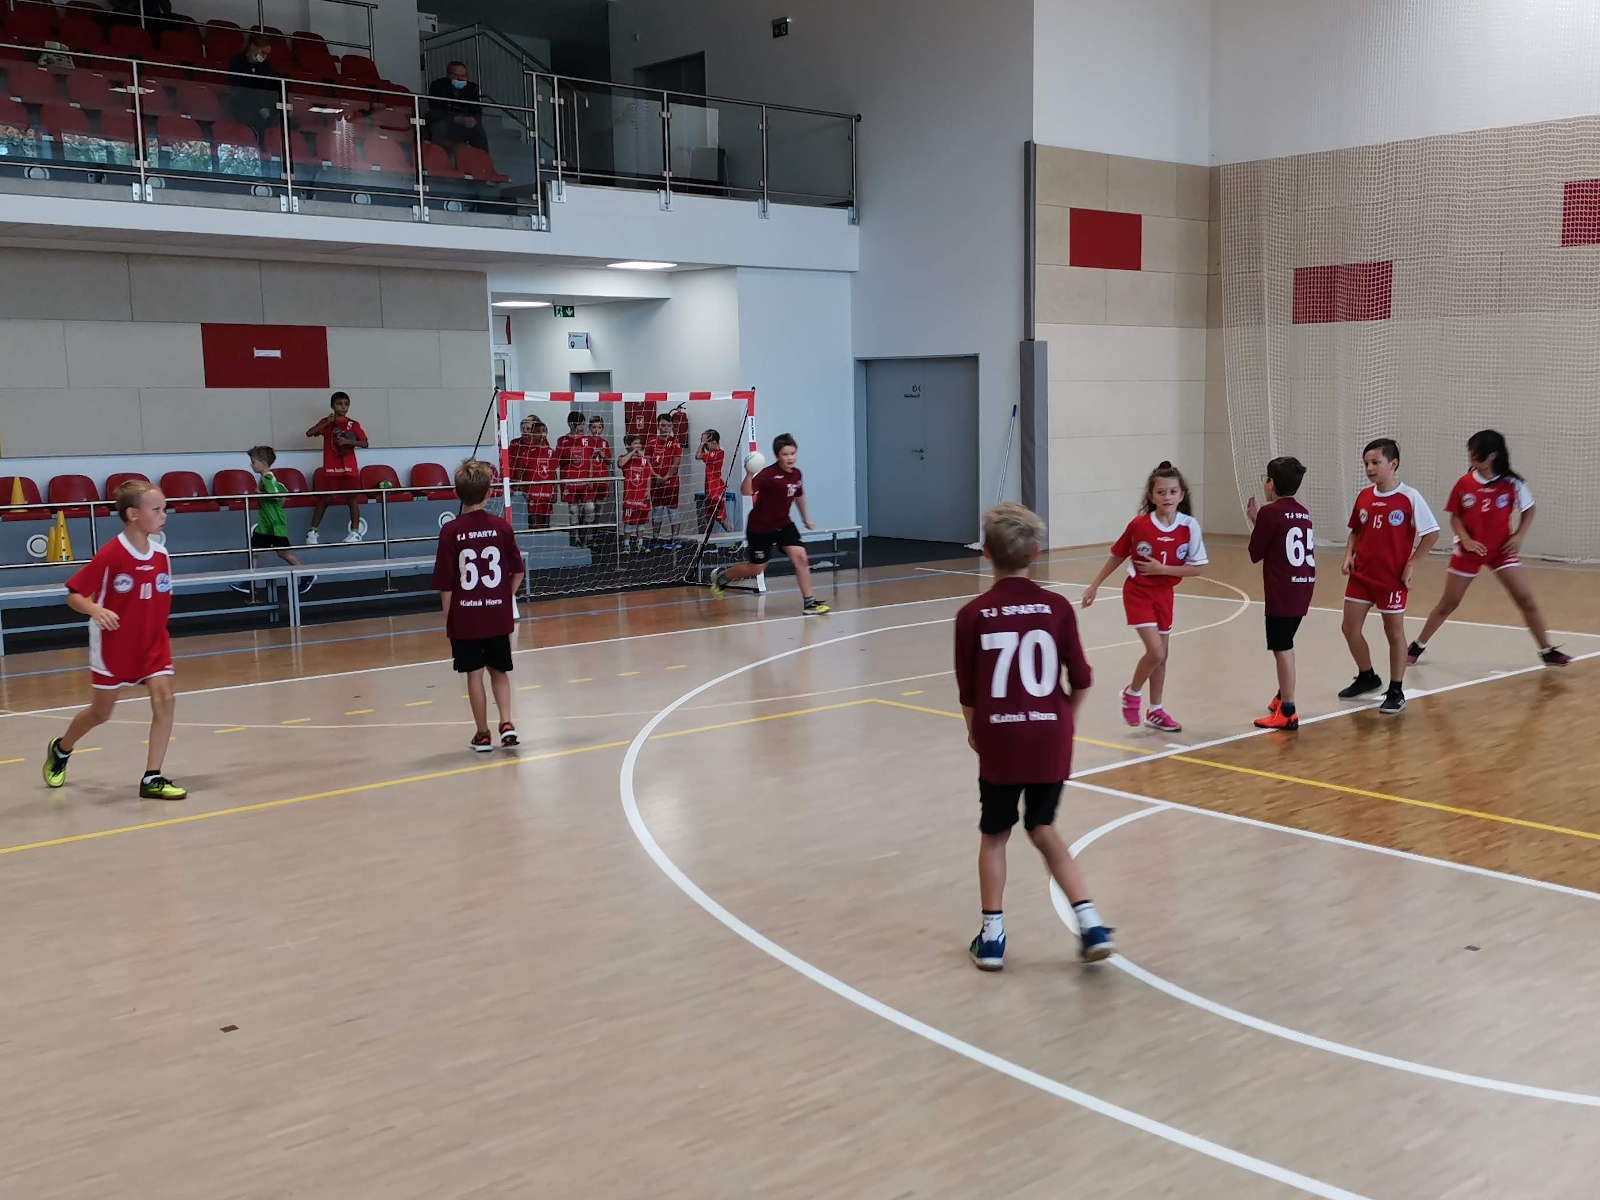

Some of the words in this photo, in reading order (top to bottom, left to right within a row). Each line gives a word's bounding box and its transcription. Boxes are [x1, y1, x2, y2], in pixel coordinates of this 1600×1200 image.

[346, 421, 354, 430] 5
[1481, 497, 1491, 512] 2
[1372, 514, 1383, 529] 15
[456, 533, 466, 541] TJ
[468, 530, 498, 539] SPARTA
[1285, 526, 1316, 567] 65
[458, 545, 502, 591] 63
[1389, 590, 1402, 604] 15
[980, 607, 999, 618] TJ
[980, 629, 1059, 699] 70
